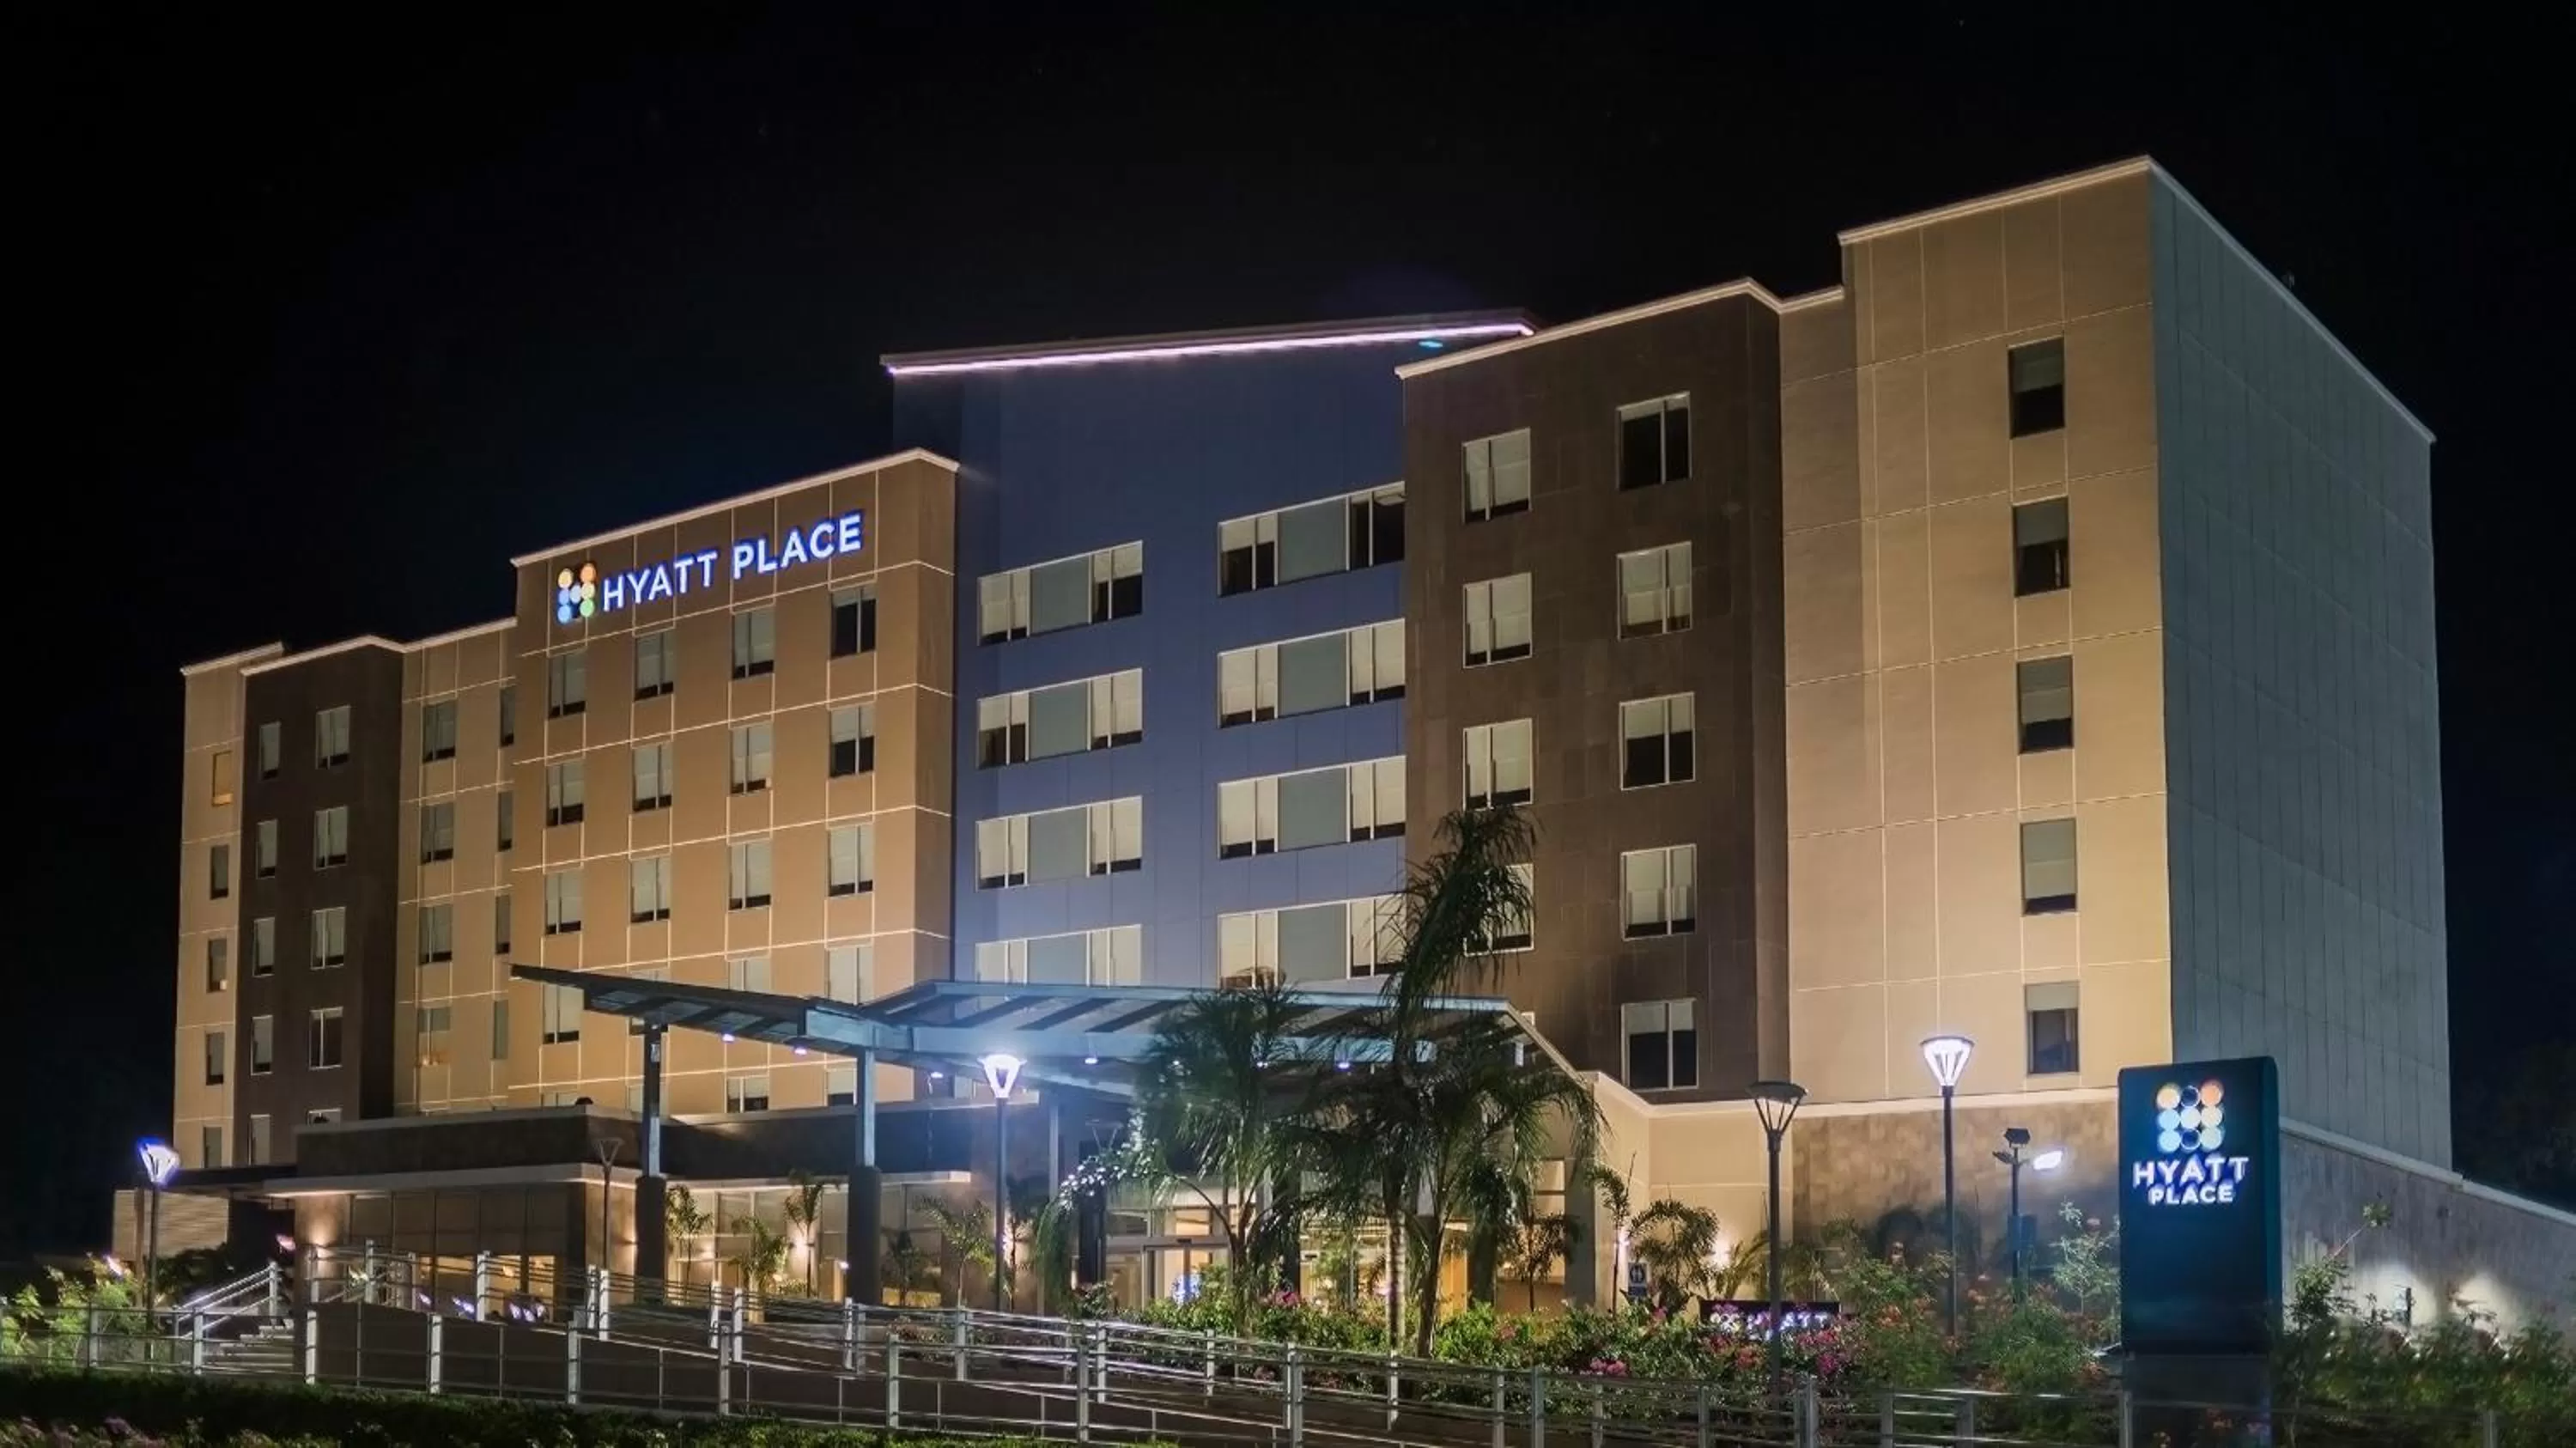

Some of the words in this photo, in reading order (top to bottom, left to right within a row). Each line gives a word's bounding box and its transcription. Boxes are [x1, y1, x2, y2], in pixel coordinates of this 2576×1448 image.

[603, 551, 718, 612] HYATT
[732, 513, 862, 581] PLACE
[2133, 1156, 2249, 1187] HYATT
[2149, 1183, 2234, 1204] PLACE
[1747, 1311, 1829, 1331] ATT
